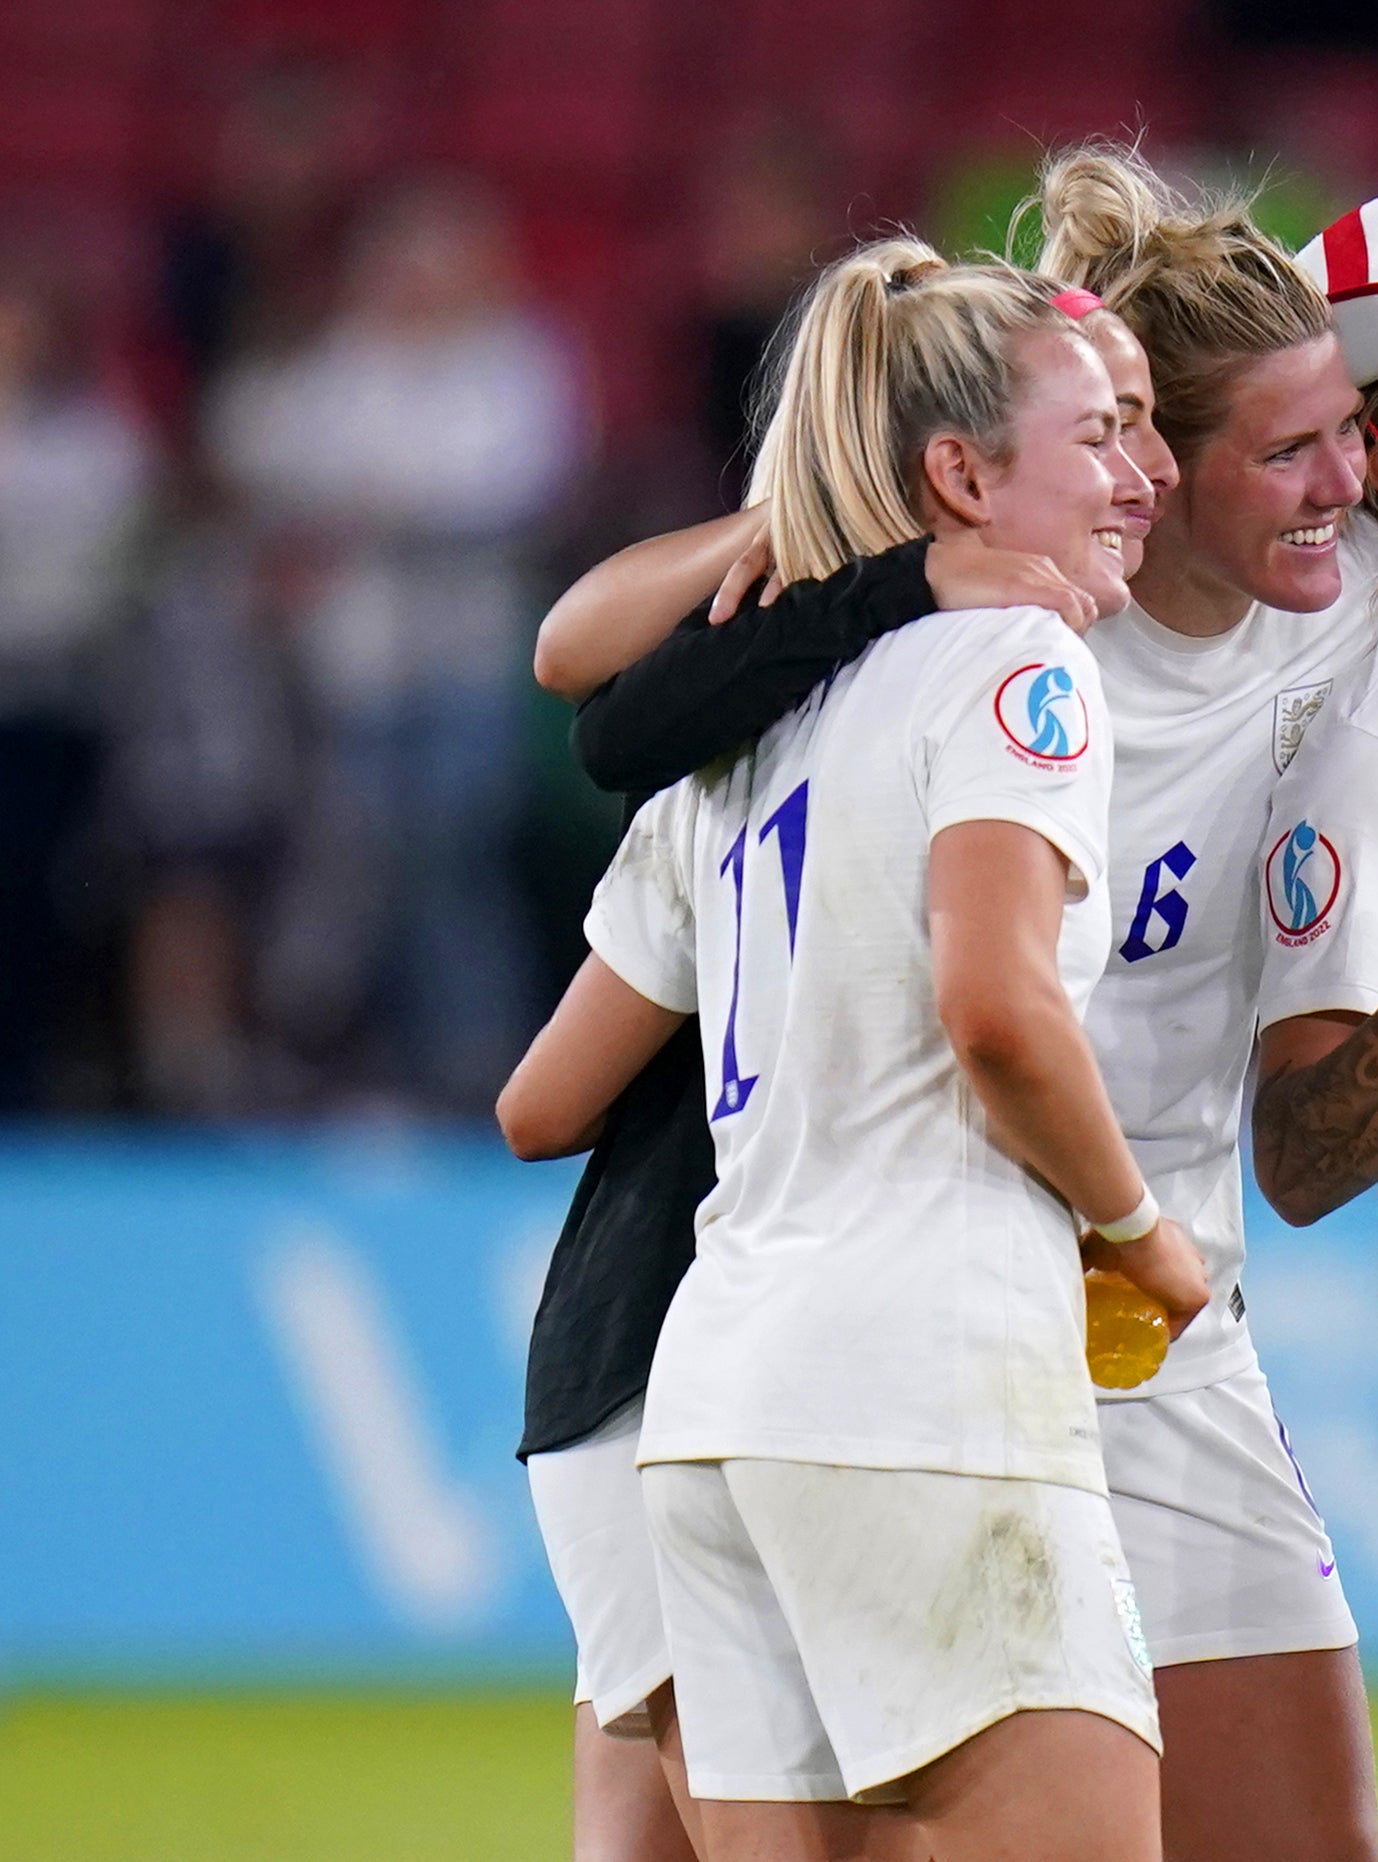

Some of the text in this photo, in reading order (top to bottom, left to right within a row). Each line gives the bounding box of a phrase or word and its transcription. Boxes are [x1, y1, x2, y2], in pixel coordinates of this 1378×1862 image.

[1005, 744, 1054, 771] ENGLAND
[1118, 840, 1197, 963] 6
[1275, 920, 1331, 948] ENGLAND 2022
[709, 778, 809, 1123] 11
